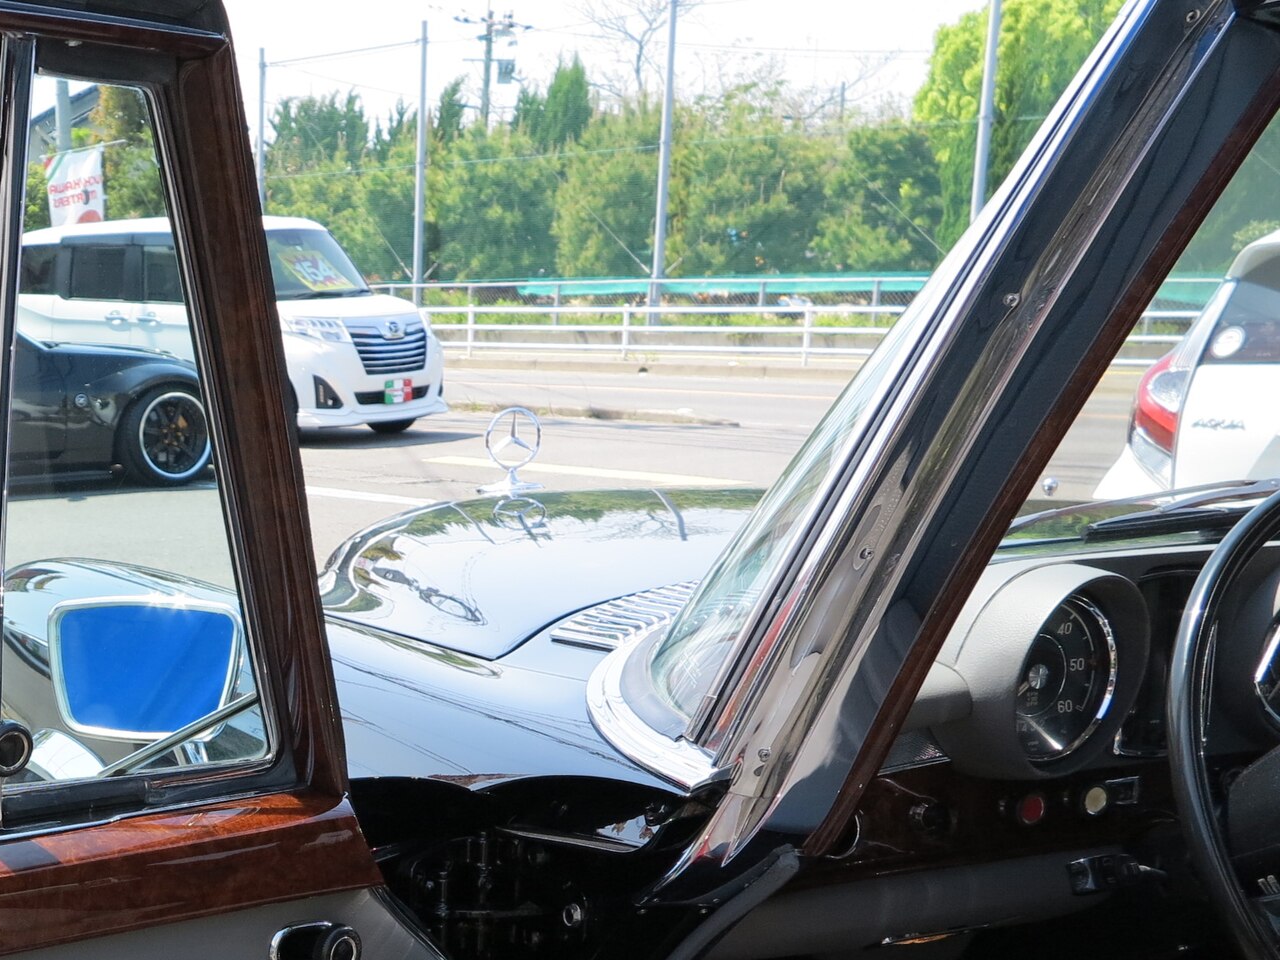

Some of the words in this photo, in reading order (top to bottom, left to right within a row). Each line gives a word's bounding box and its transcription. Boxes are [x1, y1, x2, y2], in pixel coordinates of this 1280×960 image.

[1057, 622, 1072, 635] 40
[1070, 657, 1085, 671] 50
[1057, 700, 1073, 713] 60
